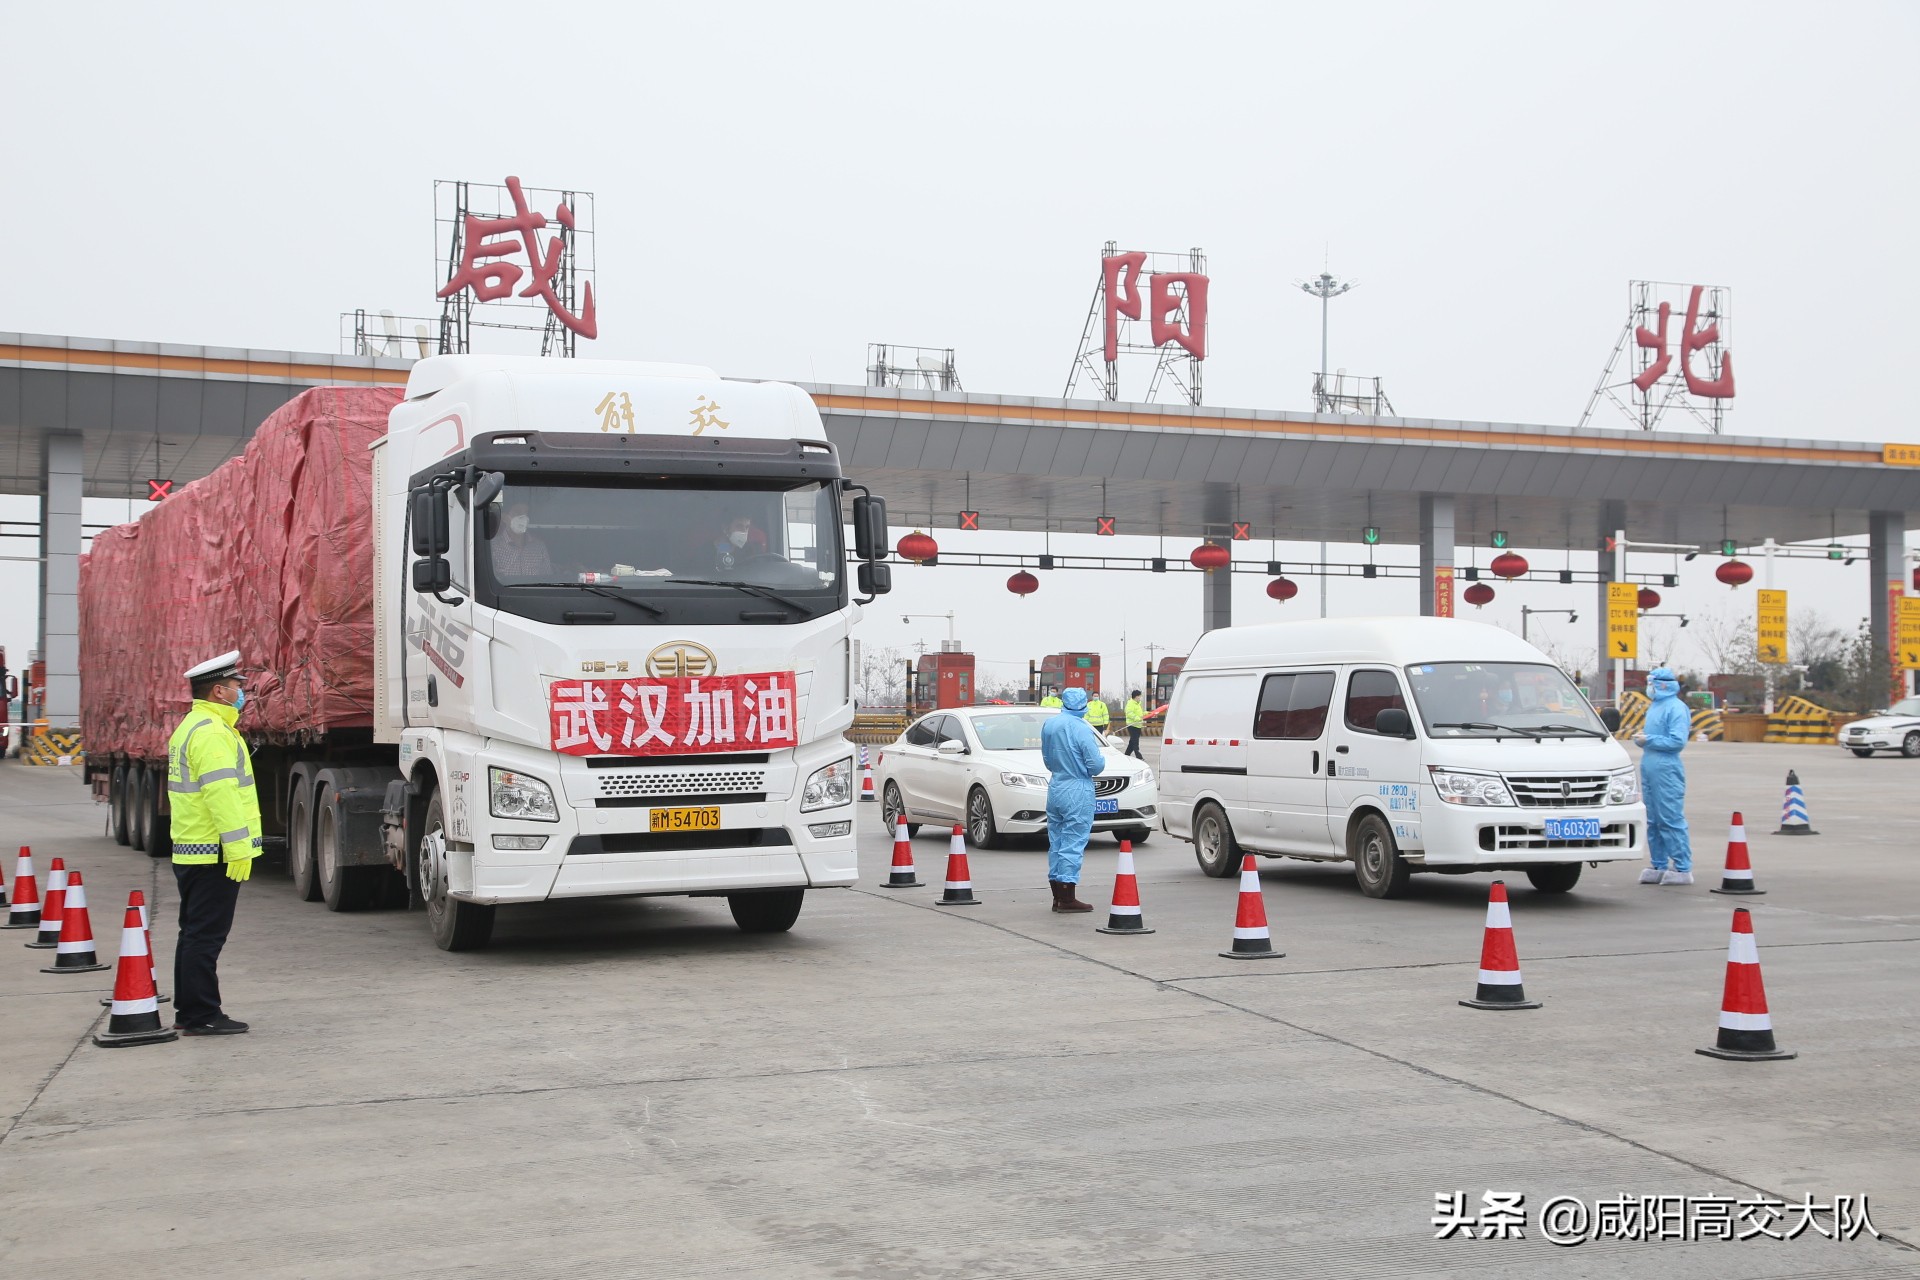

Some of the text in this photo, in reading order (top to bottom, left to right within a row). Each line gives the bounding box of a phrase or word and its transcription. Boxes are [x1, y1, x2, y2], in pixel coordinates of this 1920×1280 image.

[436, 176, 1735, 398] 咸 阳 北
[1611, 587, 1621, 597] 20
[581, 660, 628, 673] 中国一汽
[553, 675, 795, 752] 武汉加油
[1391, 785, 1408, 796] 2800
[1095, 801, 1117, 811] 5CY3
